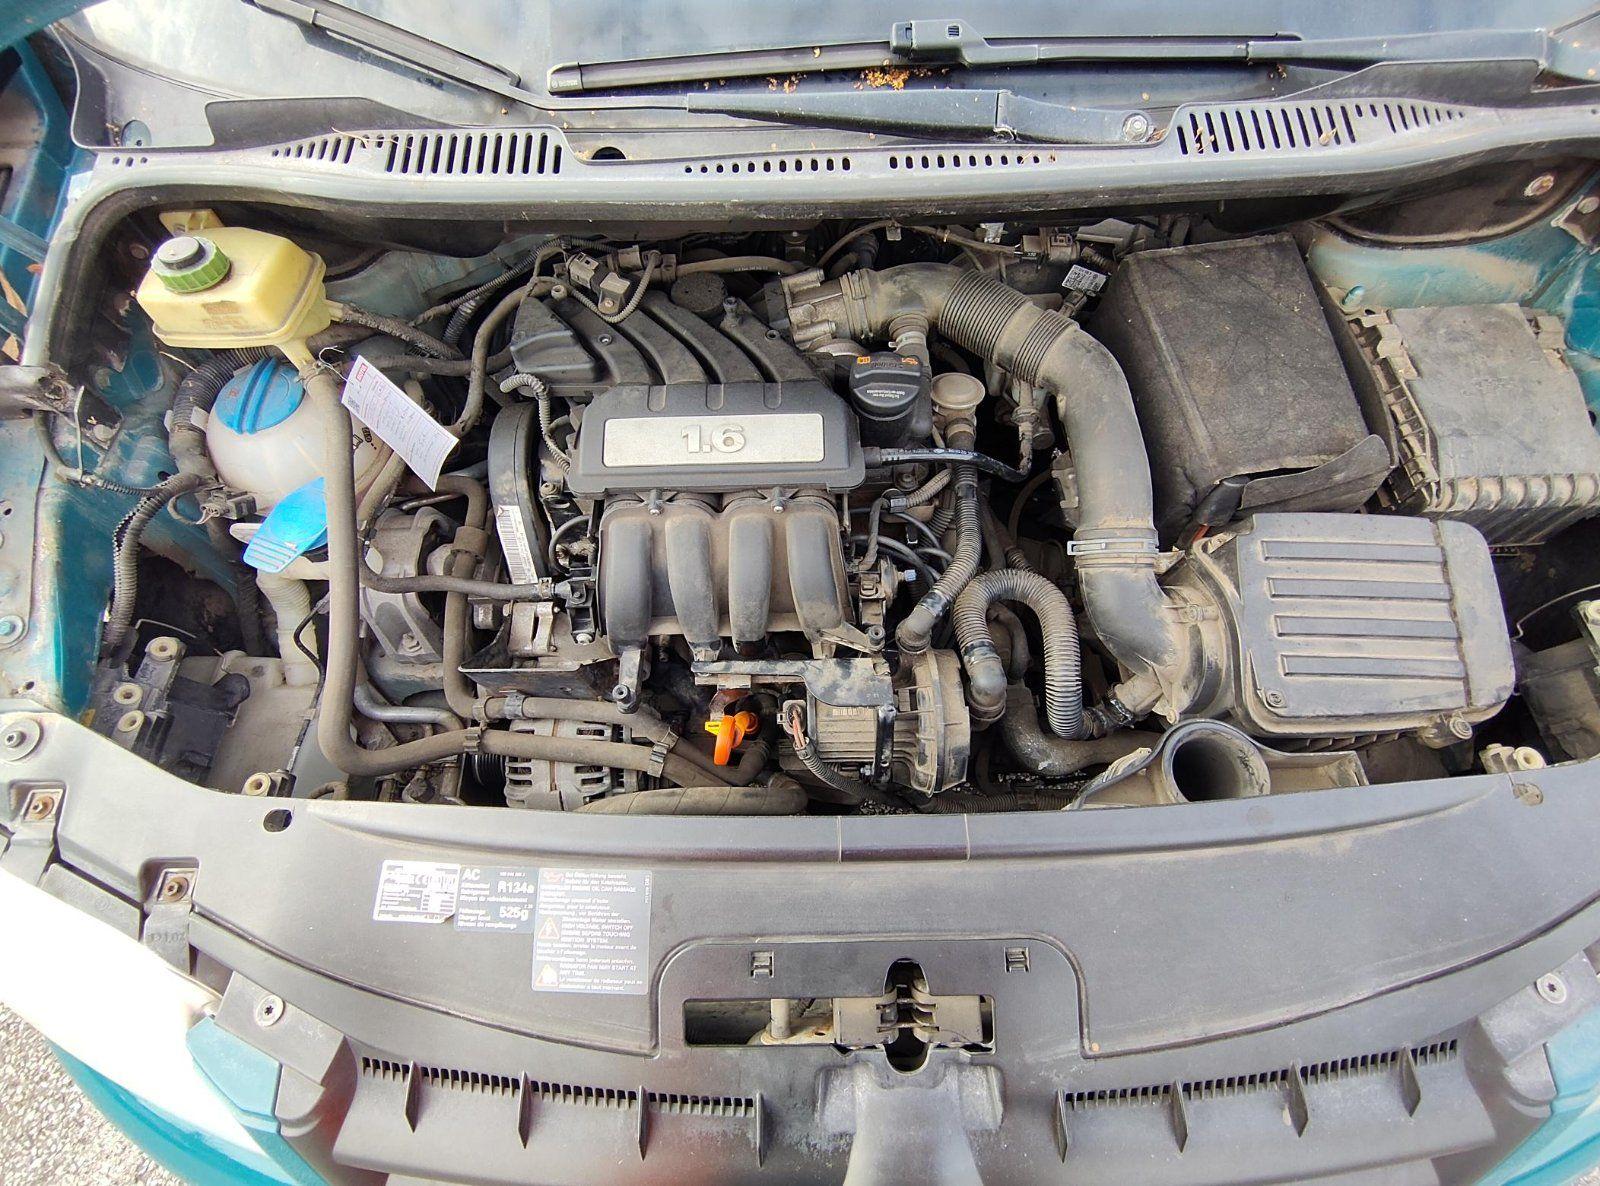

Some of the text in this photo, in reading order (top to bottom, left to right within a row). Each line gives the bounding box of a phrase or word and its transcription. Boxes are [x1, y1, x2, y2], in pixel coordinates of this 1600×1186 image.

[681, 423, 746, 453] 1.6
[462, 868, 481, 880] AC
[497, 880, 535, 894] R134a
